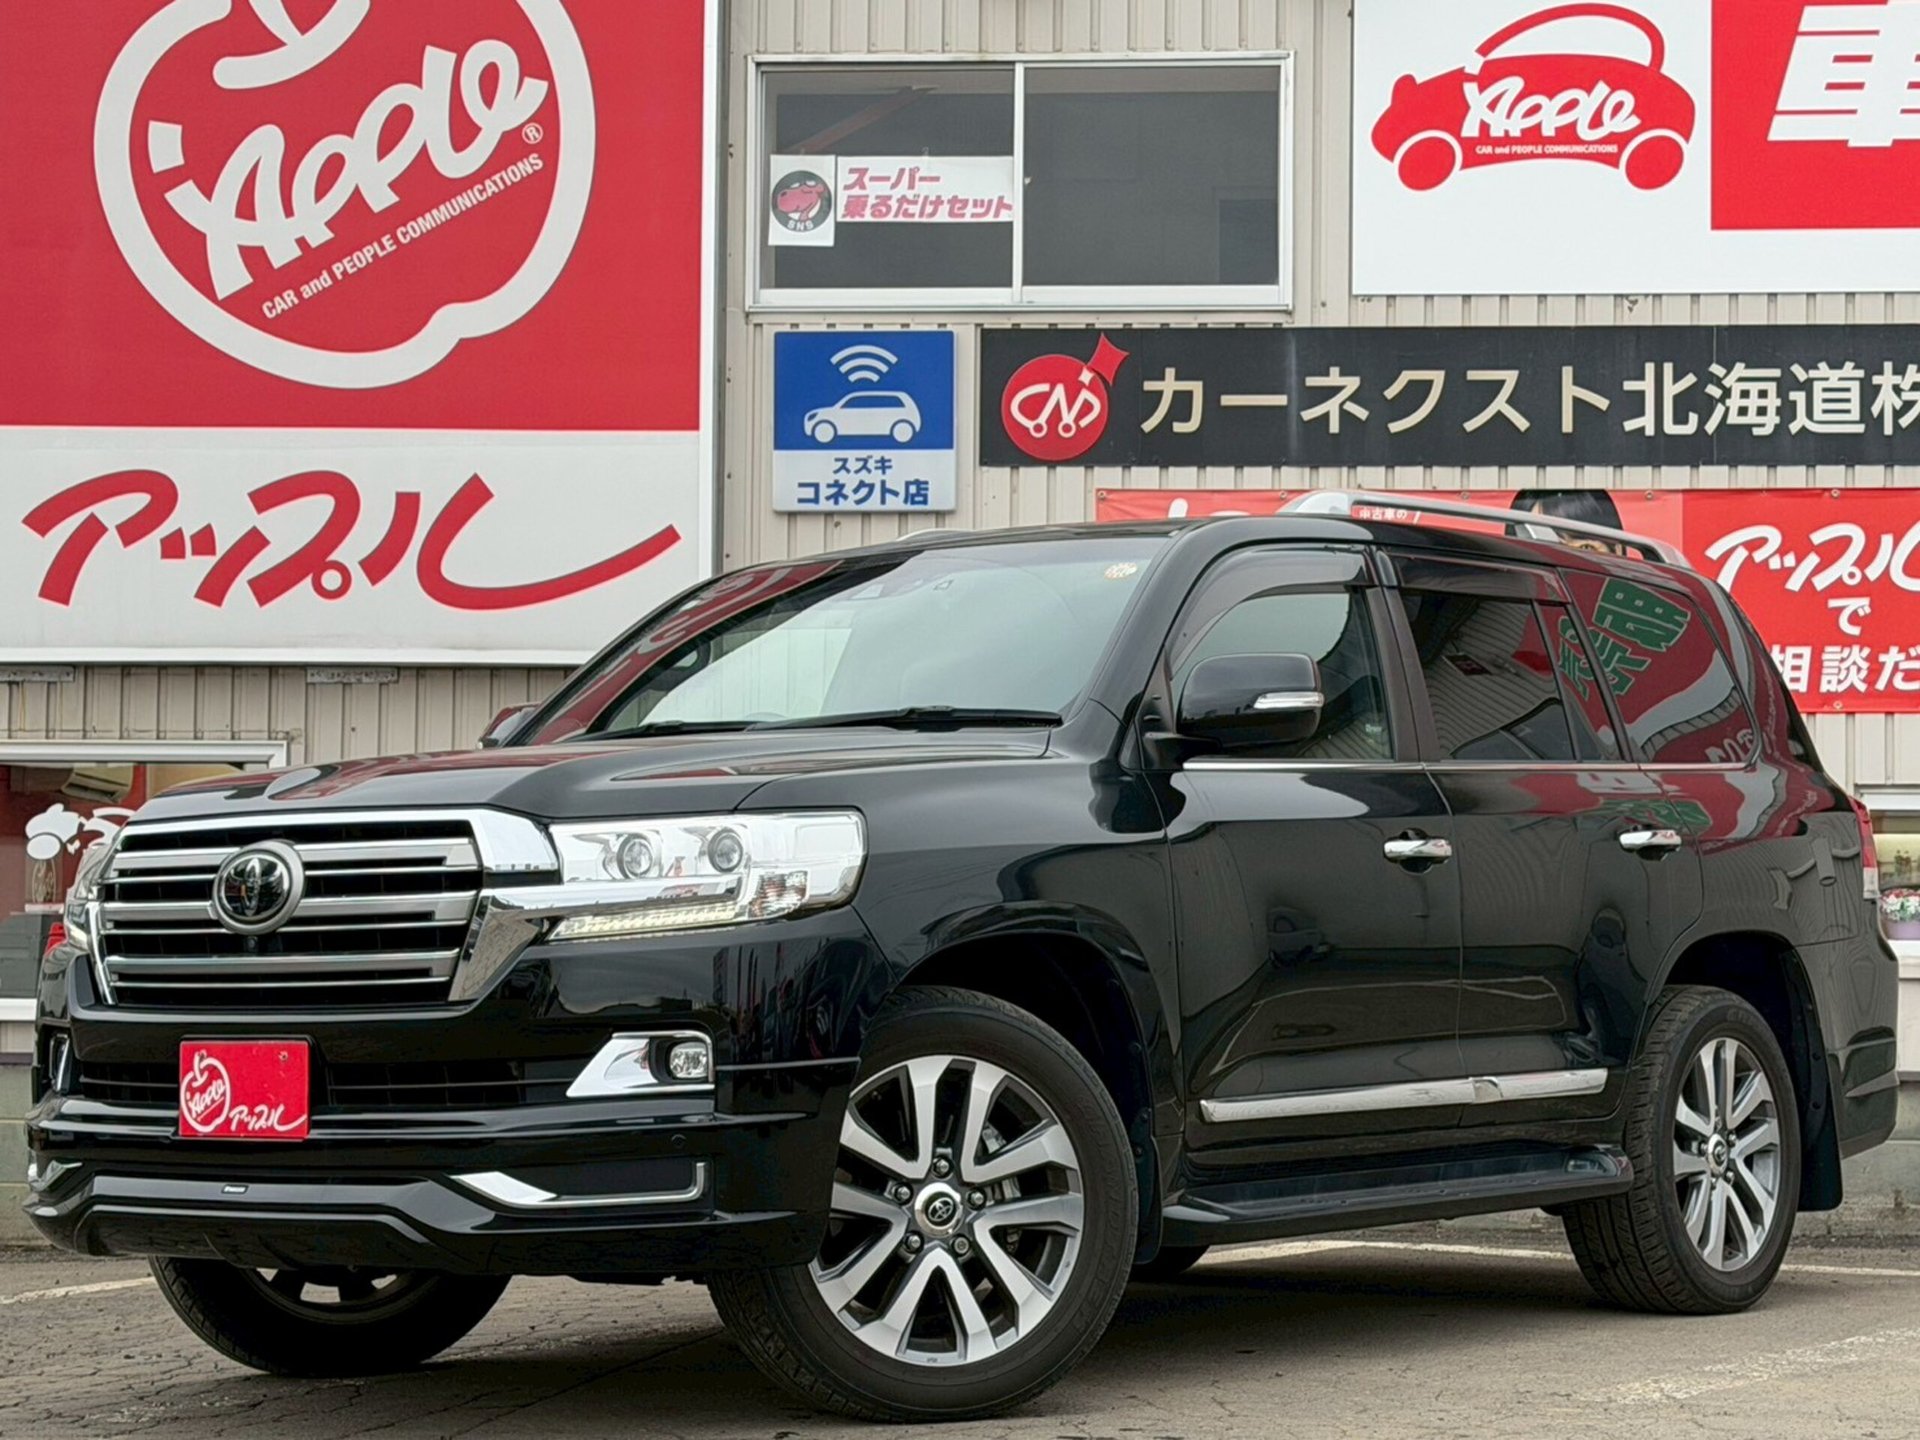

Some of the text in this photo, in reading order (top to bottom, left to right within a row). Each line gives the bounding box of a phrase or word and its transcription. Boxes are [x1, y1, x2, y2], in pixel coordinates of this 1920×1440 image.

[1767, 0, 1920, 147] 車
[1460, 76, 1642, 141] Apple
[1475, 144, 1618, 155] CAR and PEOPLE COMMUNICATIONS
[160, 39, 549, 301] Apple
[843, 166, 941, 191] スーパー
[841, 193, 1013, 219] 乗るだけセット
[262, 153, 543, 319] CAR and PEOPLE COMMUNICATIONS
[832, 455, 893, 475] スズキ
[797, 478, 930, 506] コネクト店
[21, 468, 682, 611] アップル
[1827, 596, 1872, 637] で
[188, 1079, 226, 1119] Apple
[229, 1103, 308, 1132] アップル
